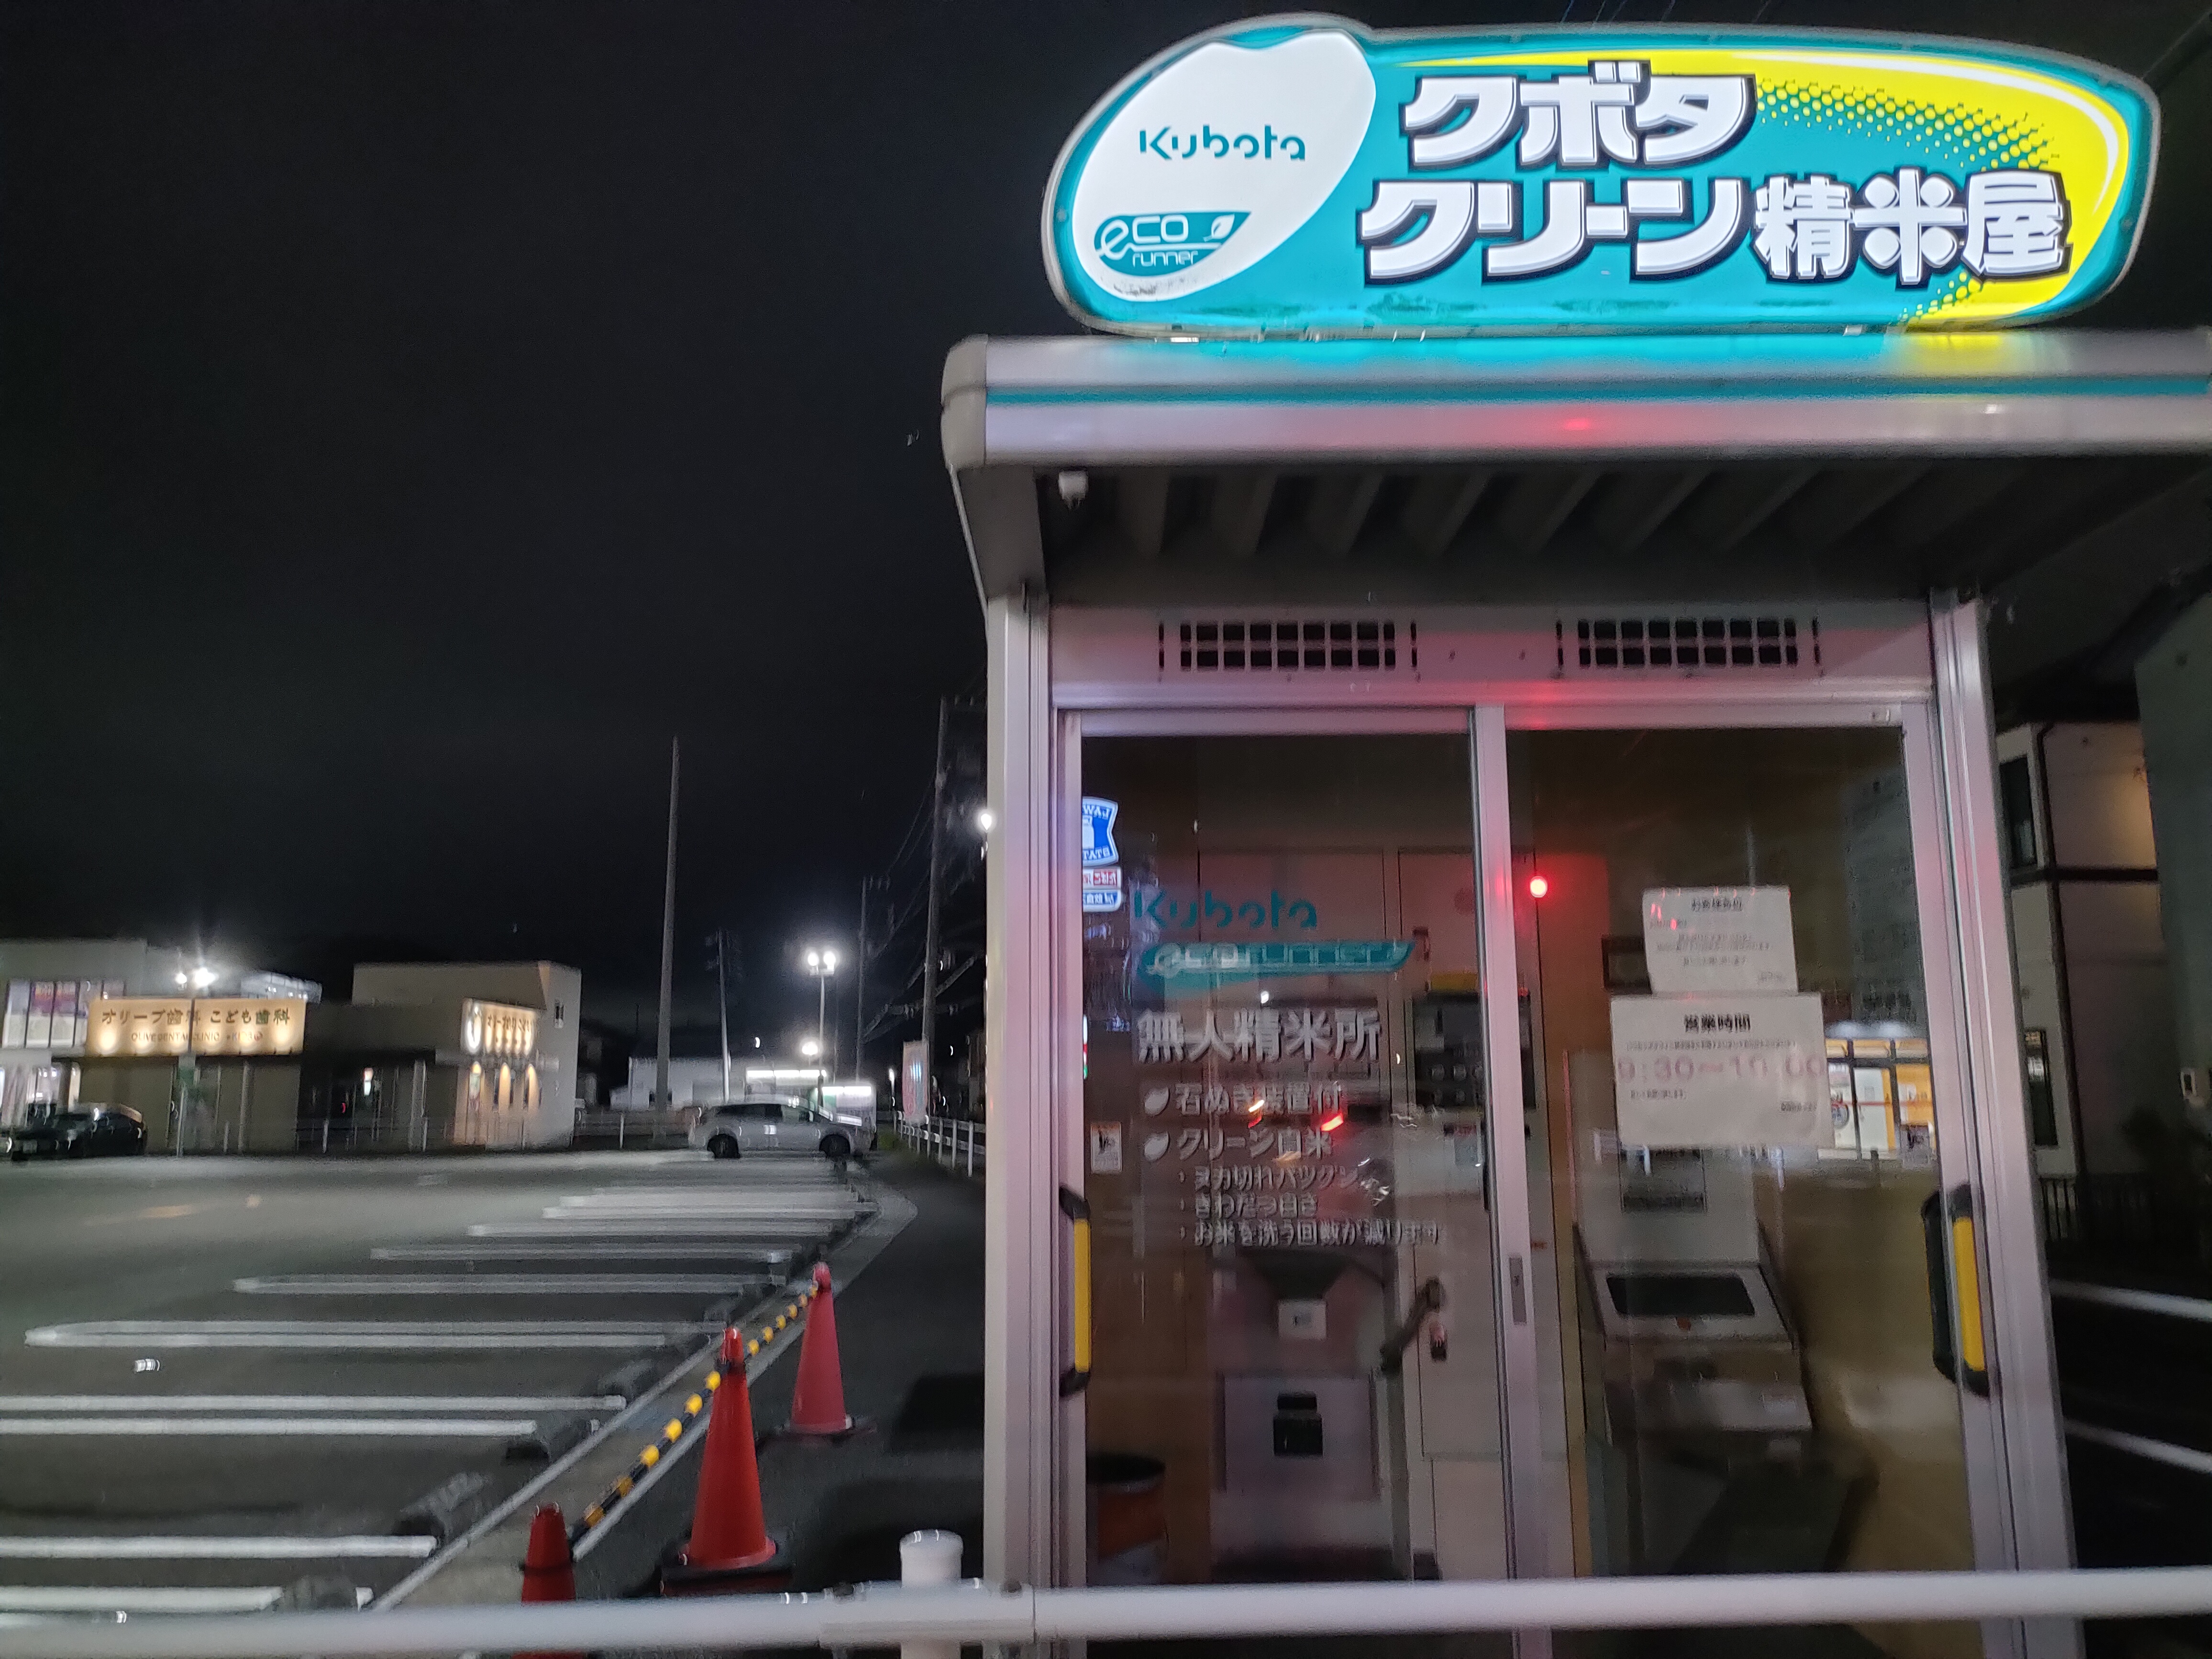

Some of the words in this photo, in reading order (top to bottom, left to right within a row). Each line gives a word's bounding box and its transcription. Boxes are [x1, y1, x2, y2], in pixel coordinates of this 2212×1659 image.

[1401, 60, 1755, 167] クボタ
[1139, 124, 1306, 161] Kubota
[1099, 214, 1189, 260] eco
[1359, 167, 2072, 286] クリーン精米屋
[1132, 250, 1198, 267] runner
[1134, 889, 1317, 929] Kubota
[101, 1008, 200, 1025] オリーブ歯科
[210, 1008, 290, 1025] こども歯科
[1139, 1007, 1381, 1063] 無人精米所
